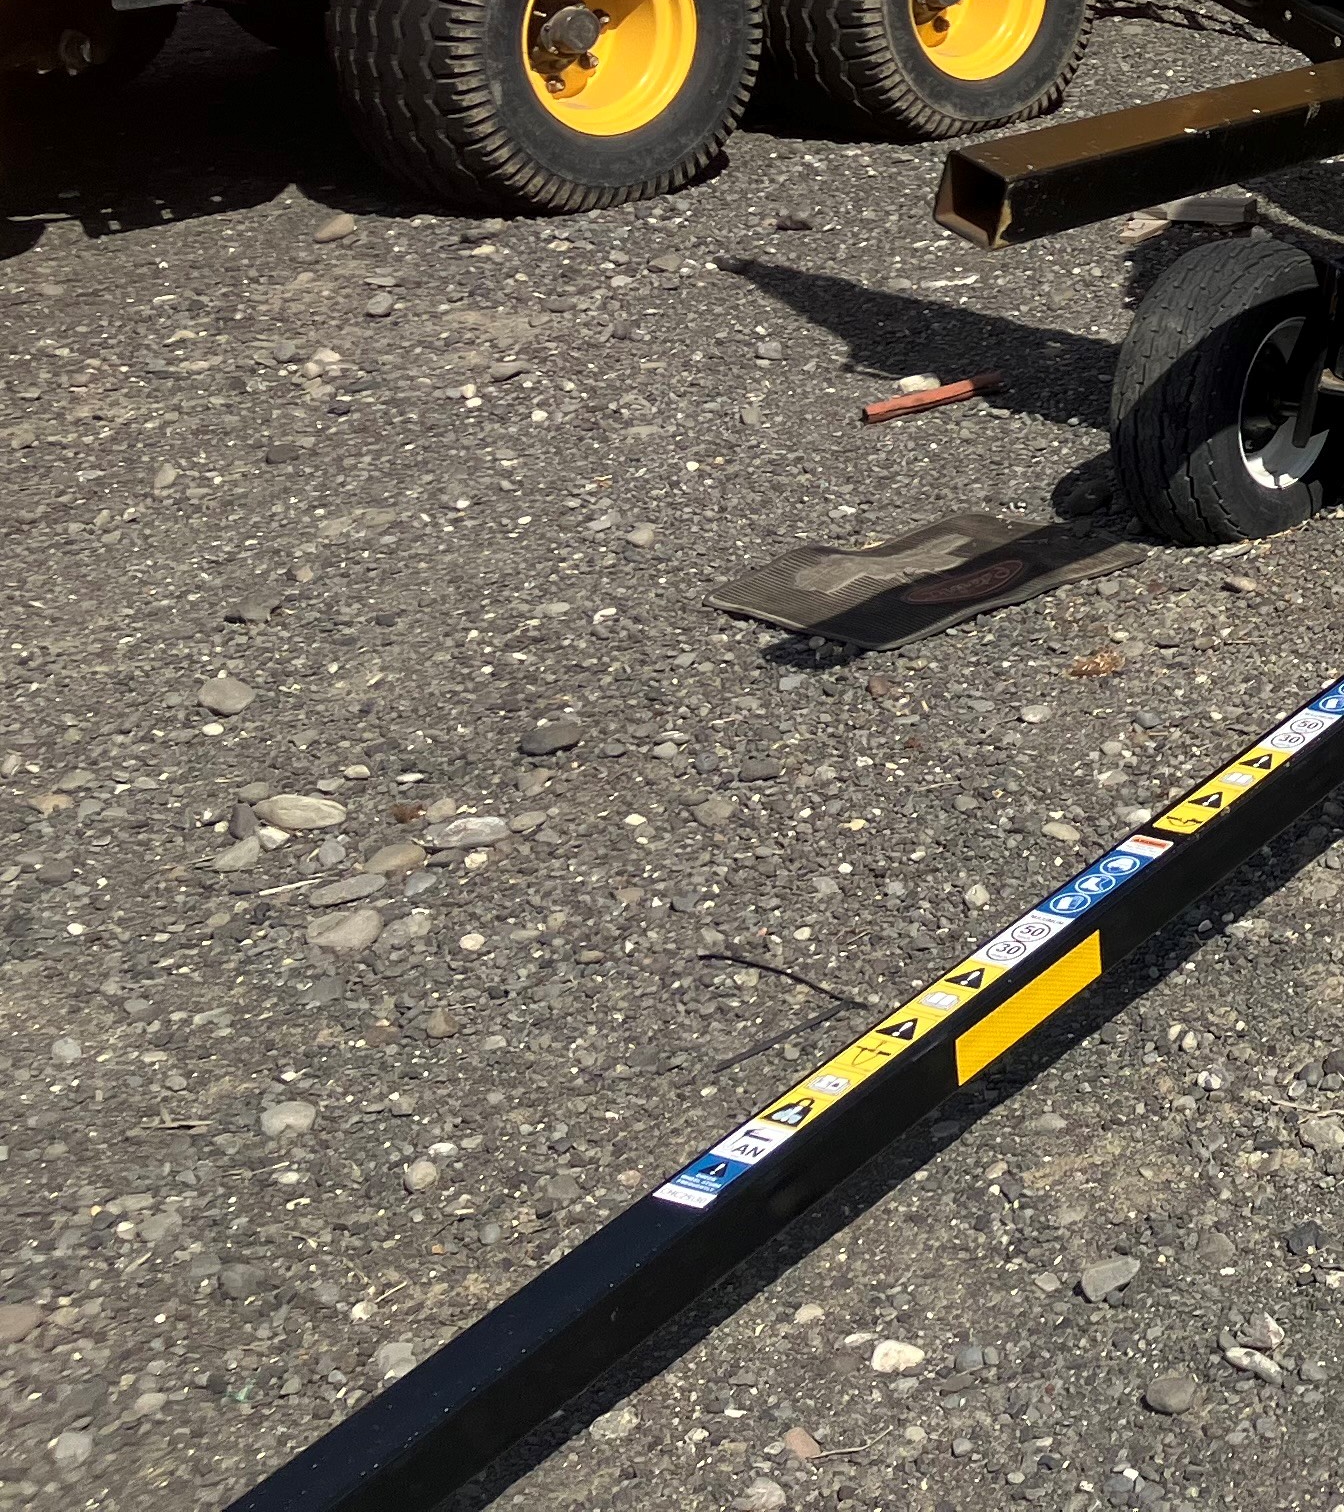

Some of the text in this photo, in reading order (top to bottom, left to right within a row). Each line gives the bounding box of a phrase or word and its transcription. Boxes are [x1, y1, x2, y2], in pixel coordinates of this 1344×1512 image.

[1297, 719, 1319, 730] 50
[1278, 734, 1301, 744] 30
[1019, 924, 1045, 937] 50
[995, 942, 1021, 955] 30
